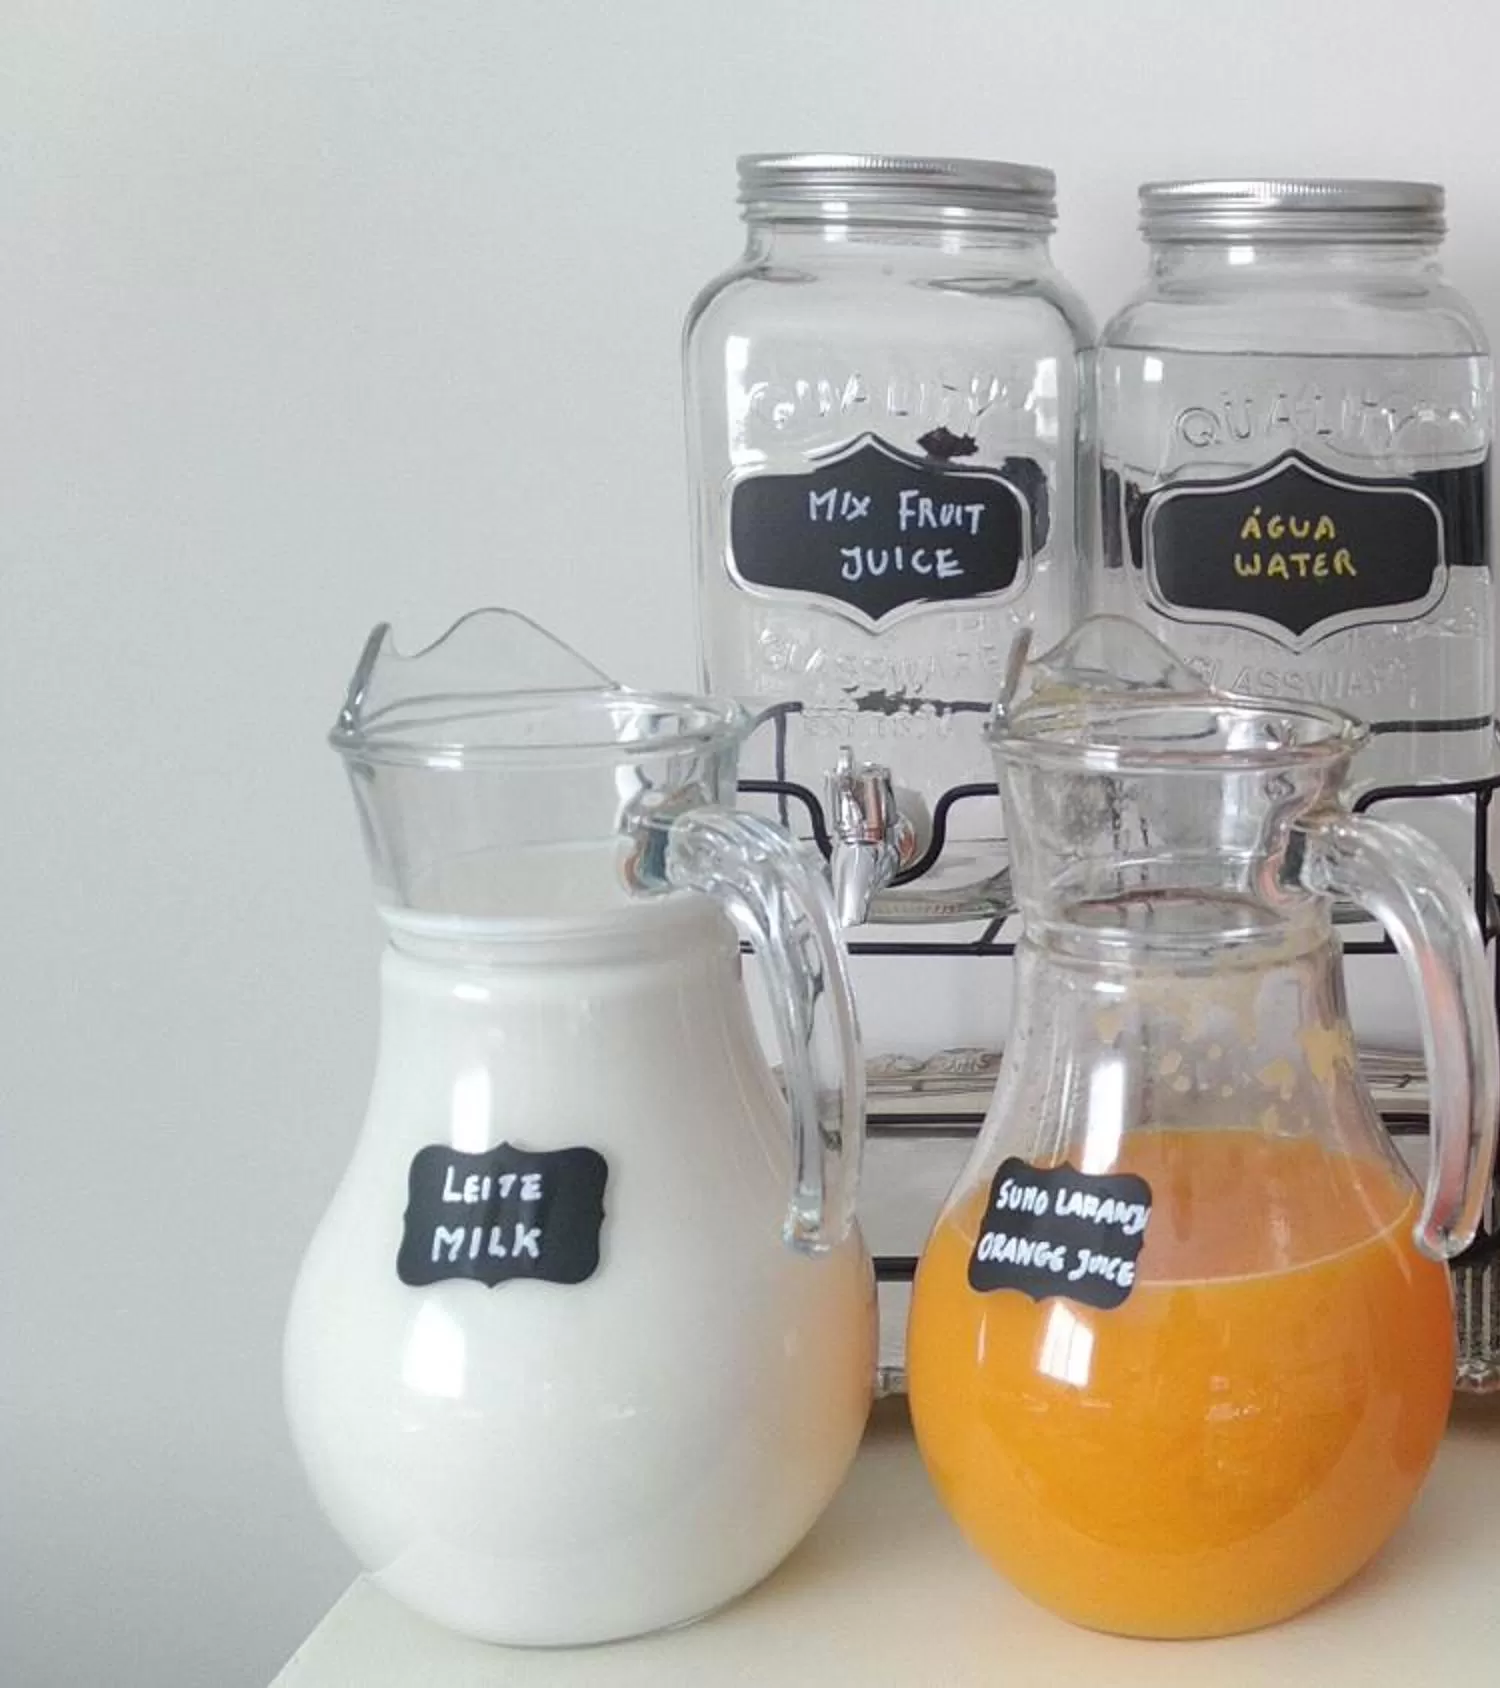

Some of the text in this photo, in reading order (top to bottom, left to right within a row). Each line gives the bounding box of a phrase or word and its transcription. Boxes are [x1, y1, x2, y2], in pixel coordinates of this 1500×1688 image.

[808, 488, 986, 536] MIX FRUIT
[1240, 505, 1337, 541] ÁGUA
[839, 545, 966, 581] JUICE
[1232, 548, 1358, 582] WATER
[441, 1164, 543, 1204] LEITE
[995, 1177, 1050, 1216] SUMO
[431, 1221, 543, 1263] MILK
[976, 1231, 1137, 1287] ORANGE JUICE
